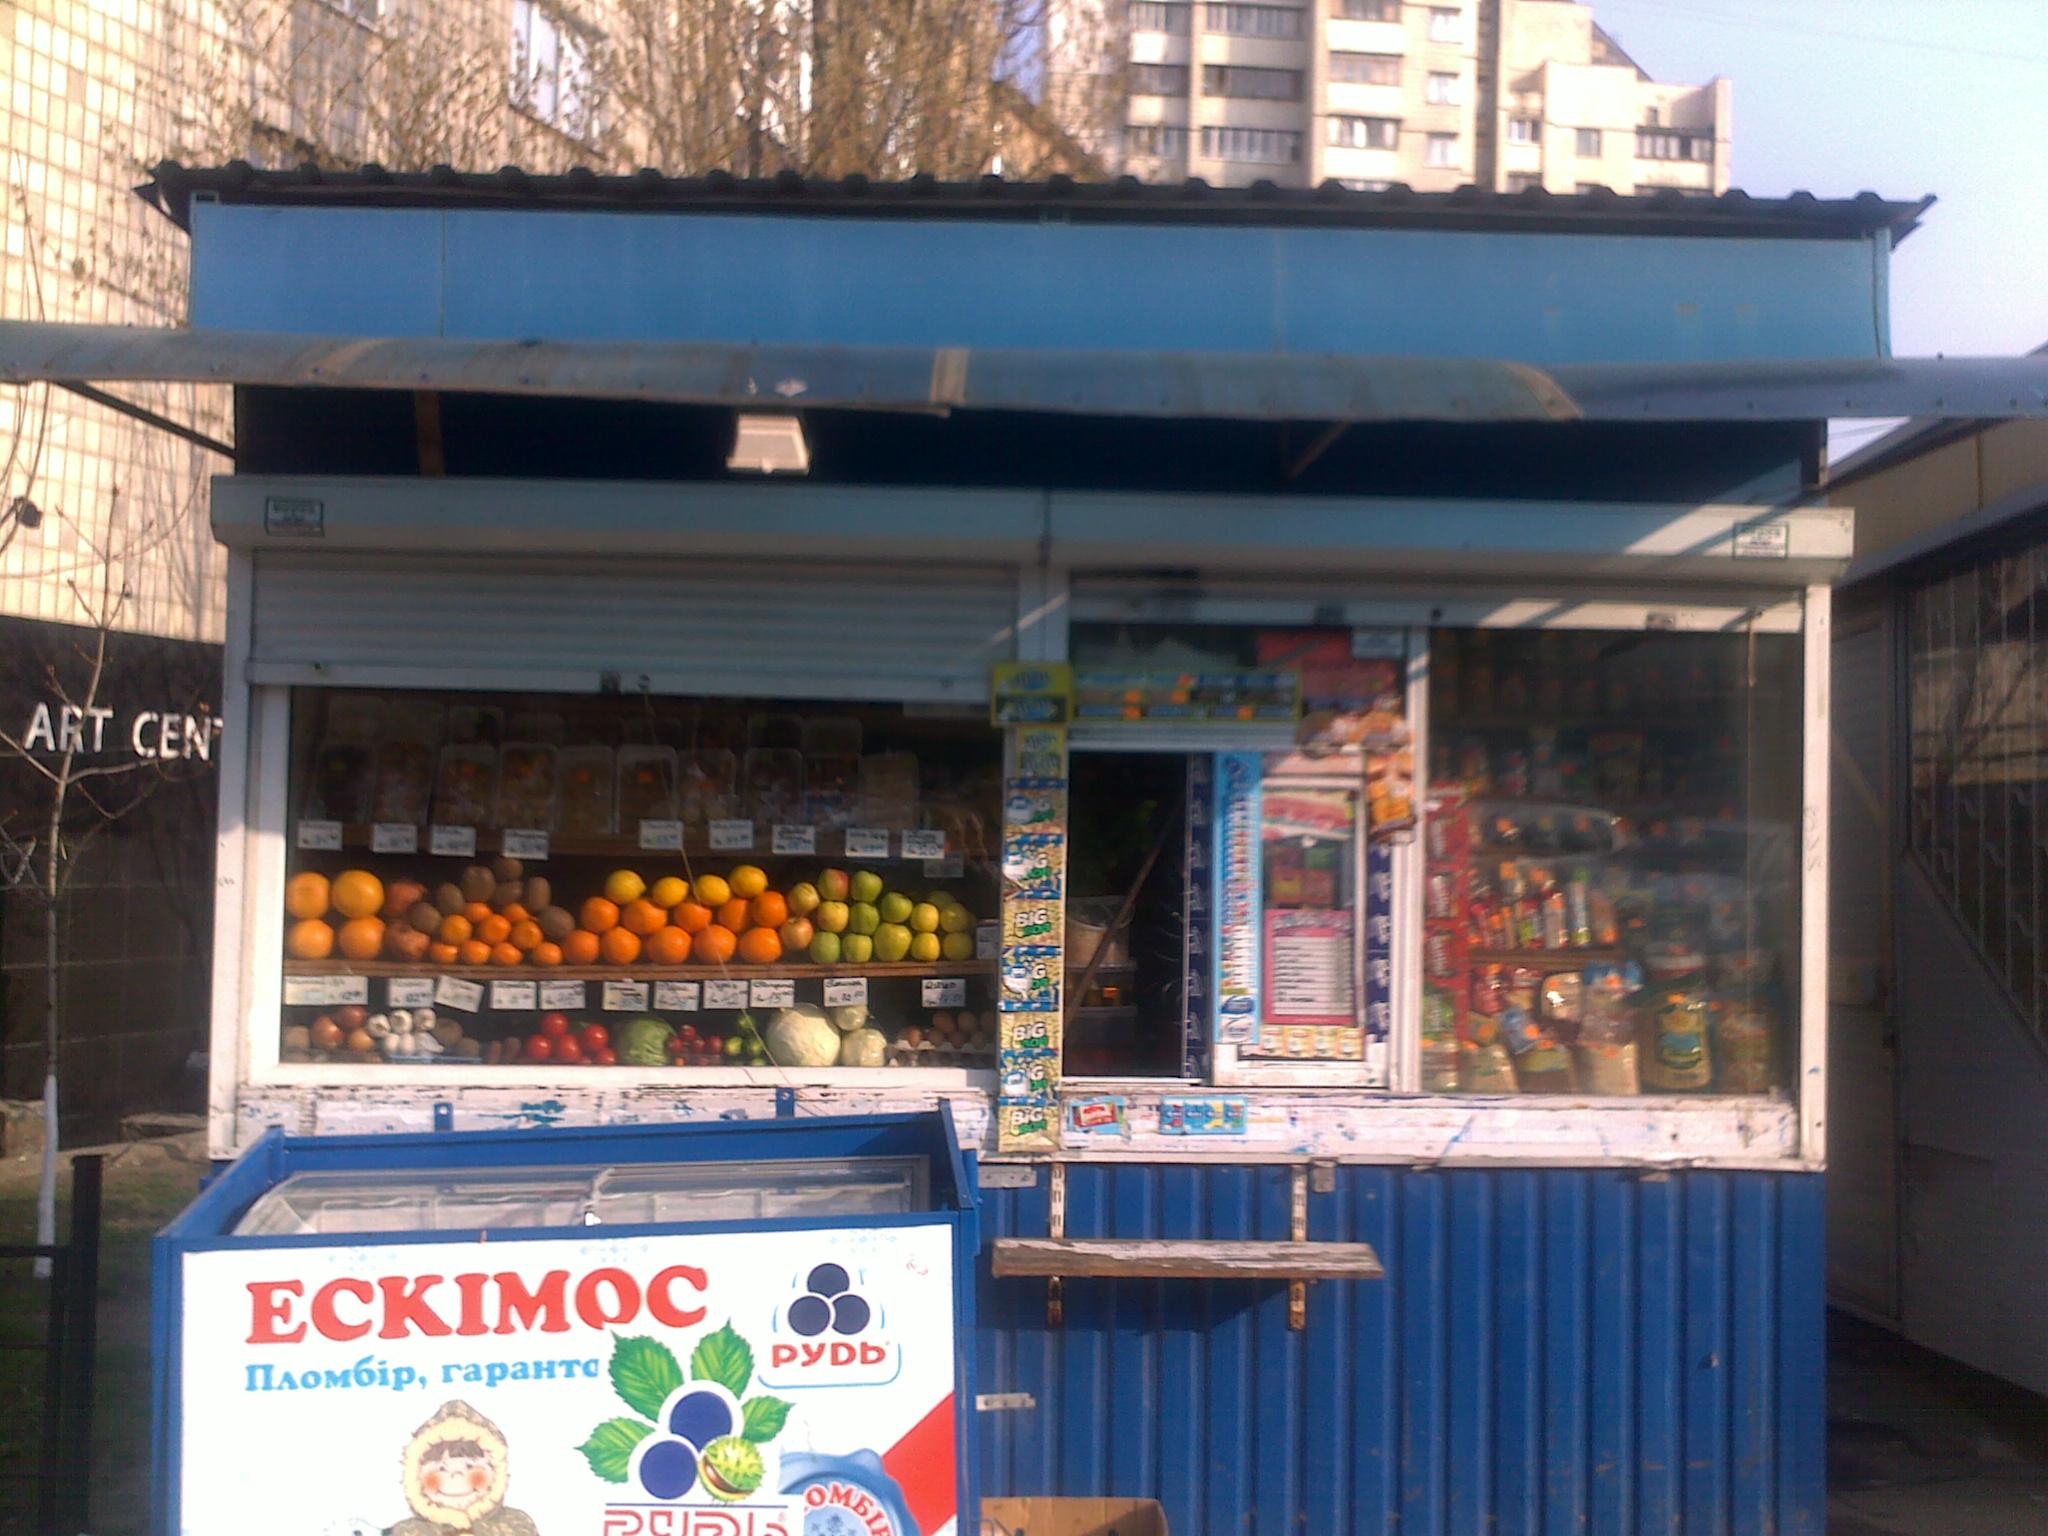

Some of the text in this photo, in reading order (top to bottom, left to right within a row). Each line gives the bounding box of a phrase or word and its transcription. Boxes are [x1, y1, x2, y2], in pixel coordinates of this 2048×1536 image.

[23, 701, 114, 753] ART
[245, 1264, 708, 1344] ЕСКІМОС
[244, 1355, 426, 1391] Пломбір,
